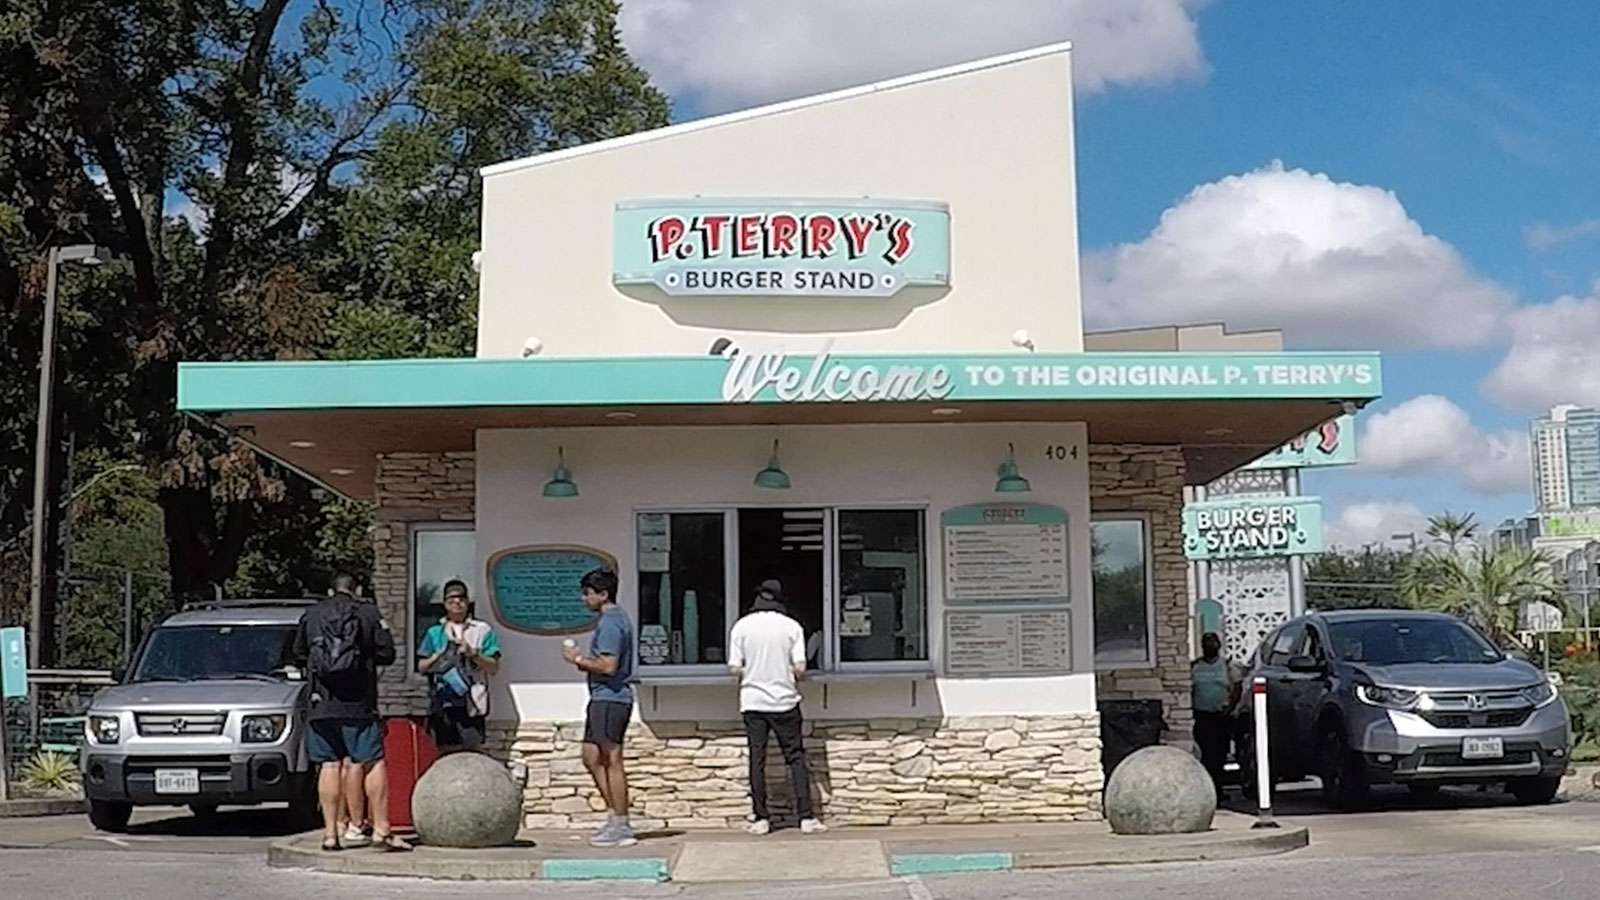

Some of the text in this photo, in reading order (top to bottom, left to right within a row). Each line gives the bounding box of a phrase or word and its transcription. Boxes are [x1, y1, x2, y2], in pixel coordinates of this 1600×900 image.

[685, 270, 875, 291] BURGER STAND
[718, 338, 1373, 403] Welcome TO THE ORIGINAL P. TERRY'S
[1045, 444, 1078, 460] 404
[1196, 505, 1298, 531] BURGER
[1206, 526, 1289, 551] STAND
